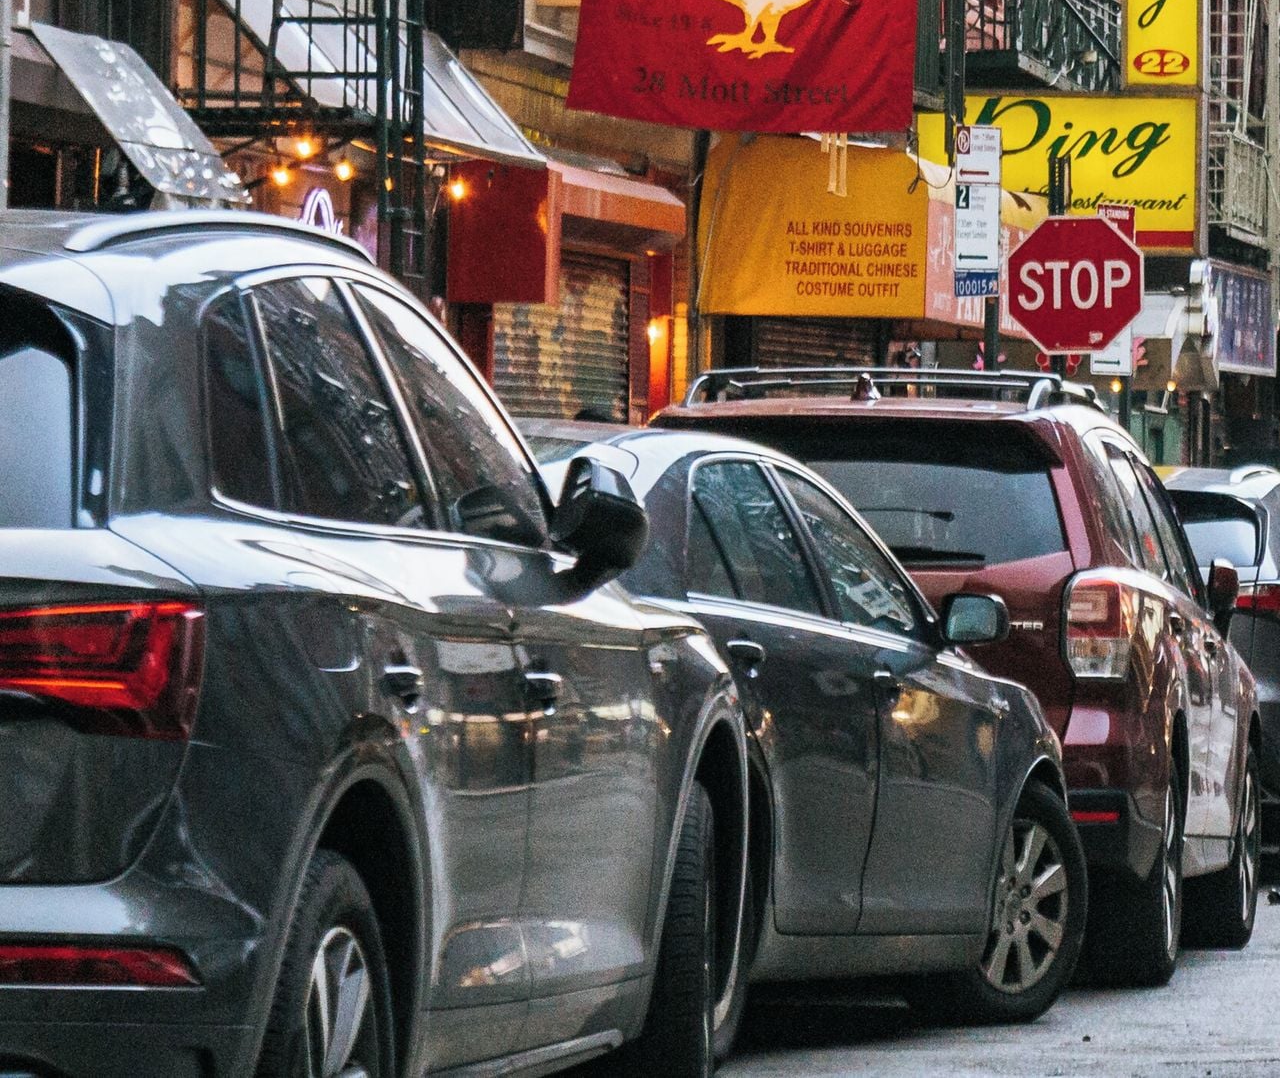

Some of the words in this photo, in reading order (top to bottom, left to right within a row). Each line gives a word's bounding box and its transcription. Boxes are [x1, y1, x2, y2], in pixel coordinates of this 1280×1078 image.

[1140, 52, 1184, 73] 22
[678, 72, 749, 105] Mott
[763, 78, 850, 106] Street
[975, 97, 1170, 178] Ping
[786, 221, 808, 236] ALL
[812, 222, 841, 236] KIND
[844, 222, 912, 237] SOUVENIRS
[790, 241, 834, 255] T-SHIRT
[837, 243, 845, 257] &
[849, 243, 908, 258] LUGGAGE
[785, 261, 863, 276] TRADITIONAL
[866, 262, 919, 278] CHINESE
[796, 281, 854, 296] COSTUME
[858, 282, 900, 298] OUTFIT
[1018, 259, 1132, 311] STOP
